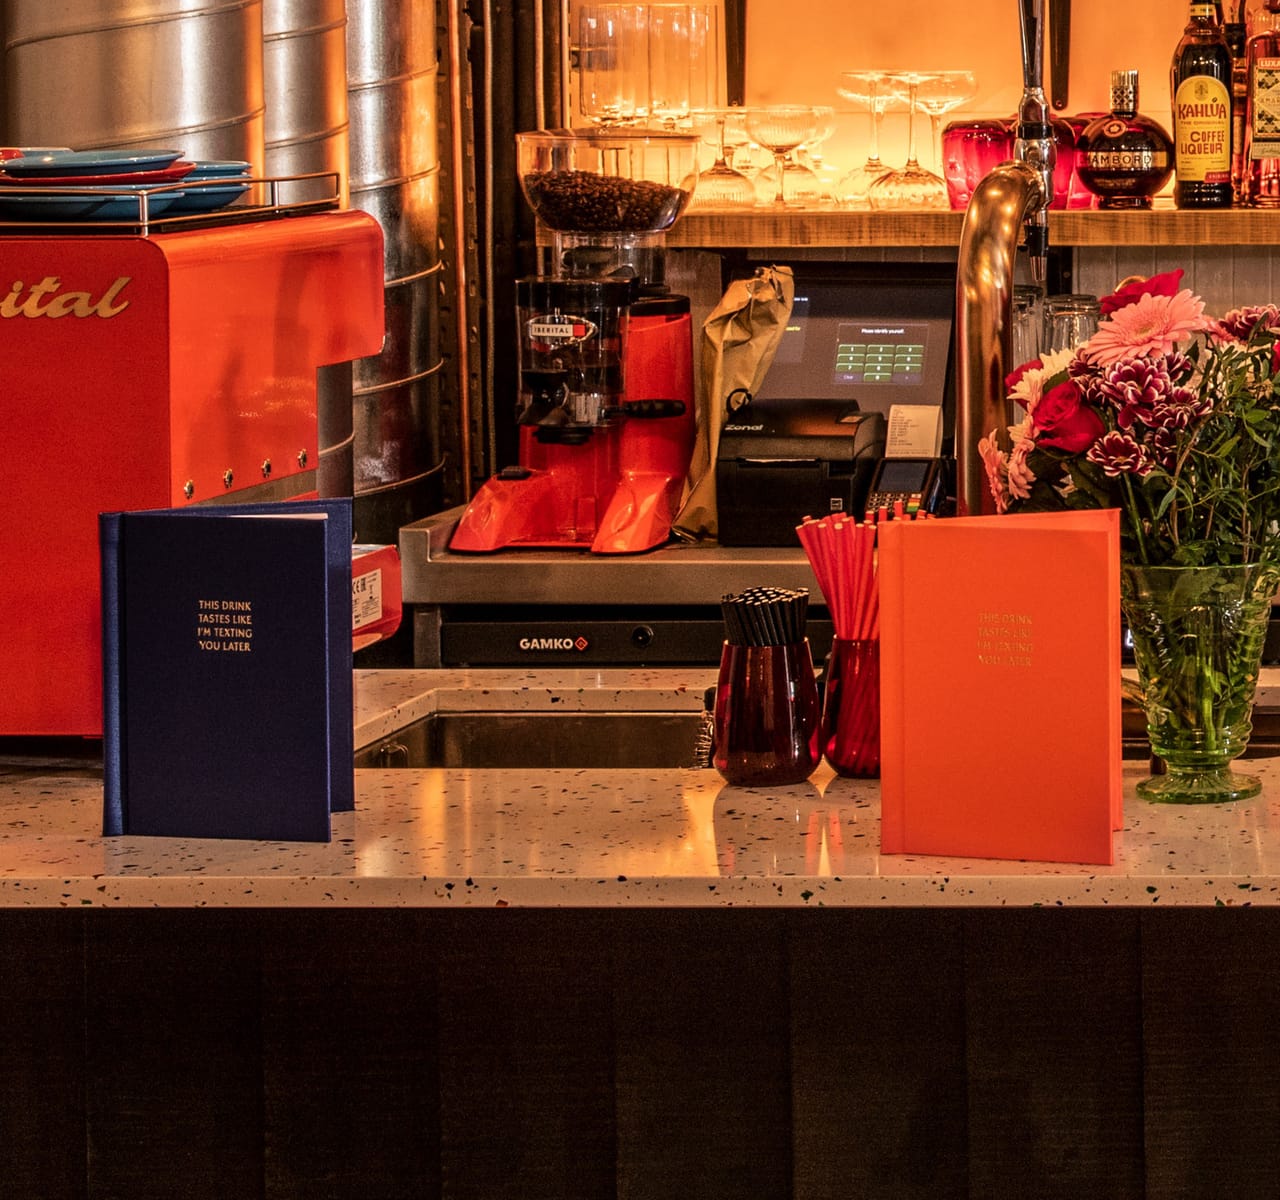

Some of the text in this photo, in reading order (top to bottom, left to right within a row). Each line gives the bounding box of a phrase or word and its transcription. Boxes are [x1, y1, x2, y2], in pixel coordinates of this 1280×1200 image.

[1178, 97, 1227, 120] KAHLÚA
[1190, 130, 1225, 143] COFFEE
[1180, 143, 1223, 155] LIQUEUR
[1086, 155, 1152, 164] HAMBORD
[0, 276, 132, 319] ital
[724, 424, 764, 432] Zonal
[199, 600, 252, 611] THIS DRINK
[198, 613, 252, 625] TASTES LIKE
[1002, 614, 1033, 625] DRINK
[197, 627, 253, 638] I'M TEXTING
[199, 640, 251, 651] YOU LATER
[519, 638, 574, 650] GAMKO
